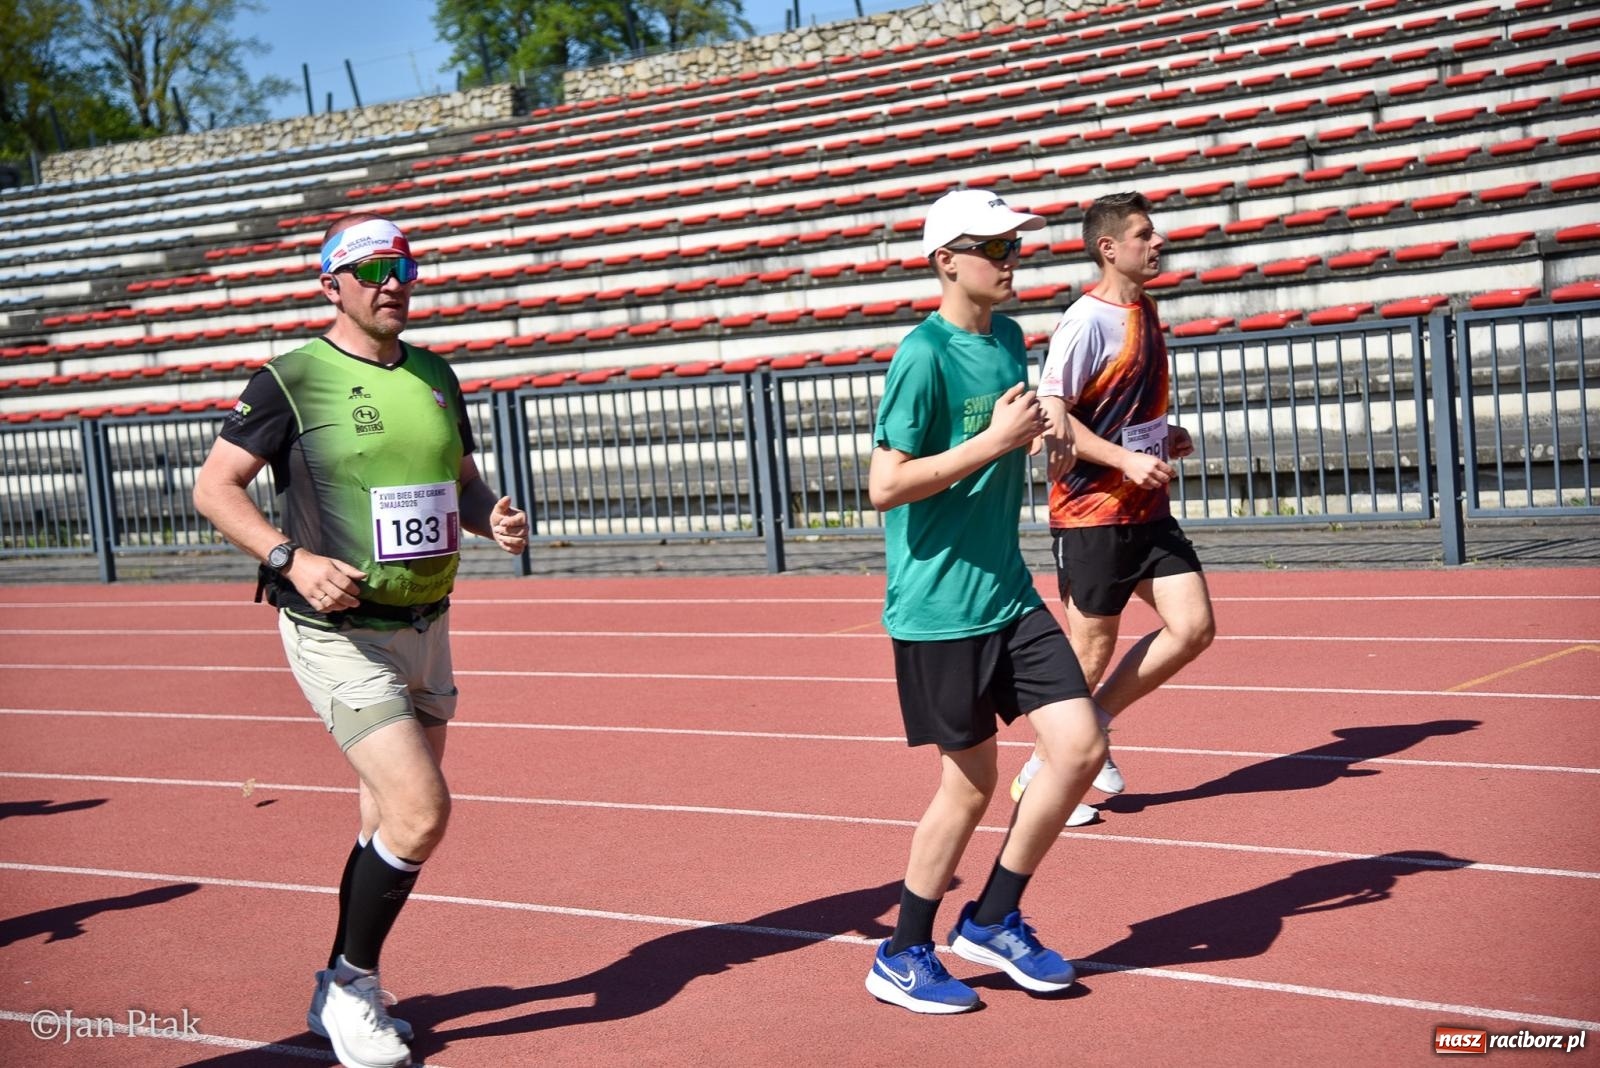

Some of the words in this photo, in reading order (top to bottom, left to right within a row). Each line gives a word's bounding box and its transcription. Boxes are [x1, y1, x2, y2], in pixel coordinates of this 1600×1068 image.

[348, 239, 389, 252] MARATHON
[396, 491, 412, 500] BIEG
[413, 490, 425, 499] BEZ
[392, 515, 440, 547] 183
